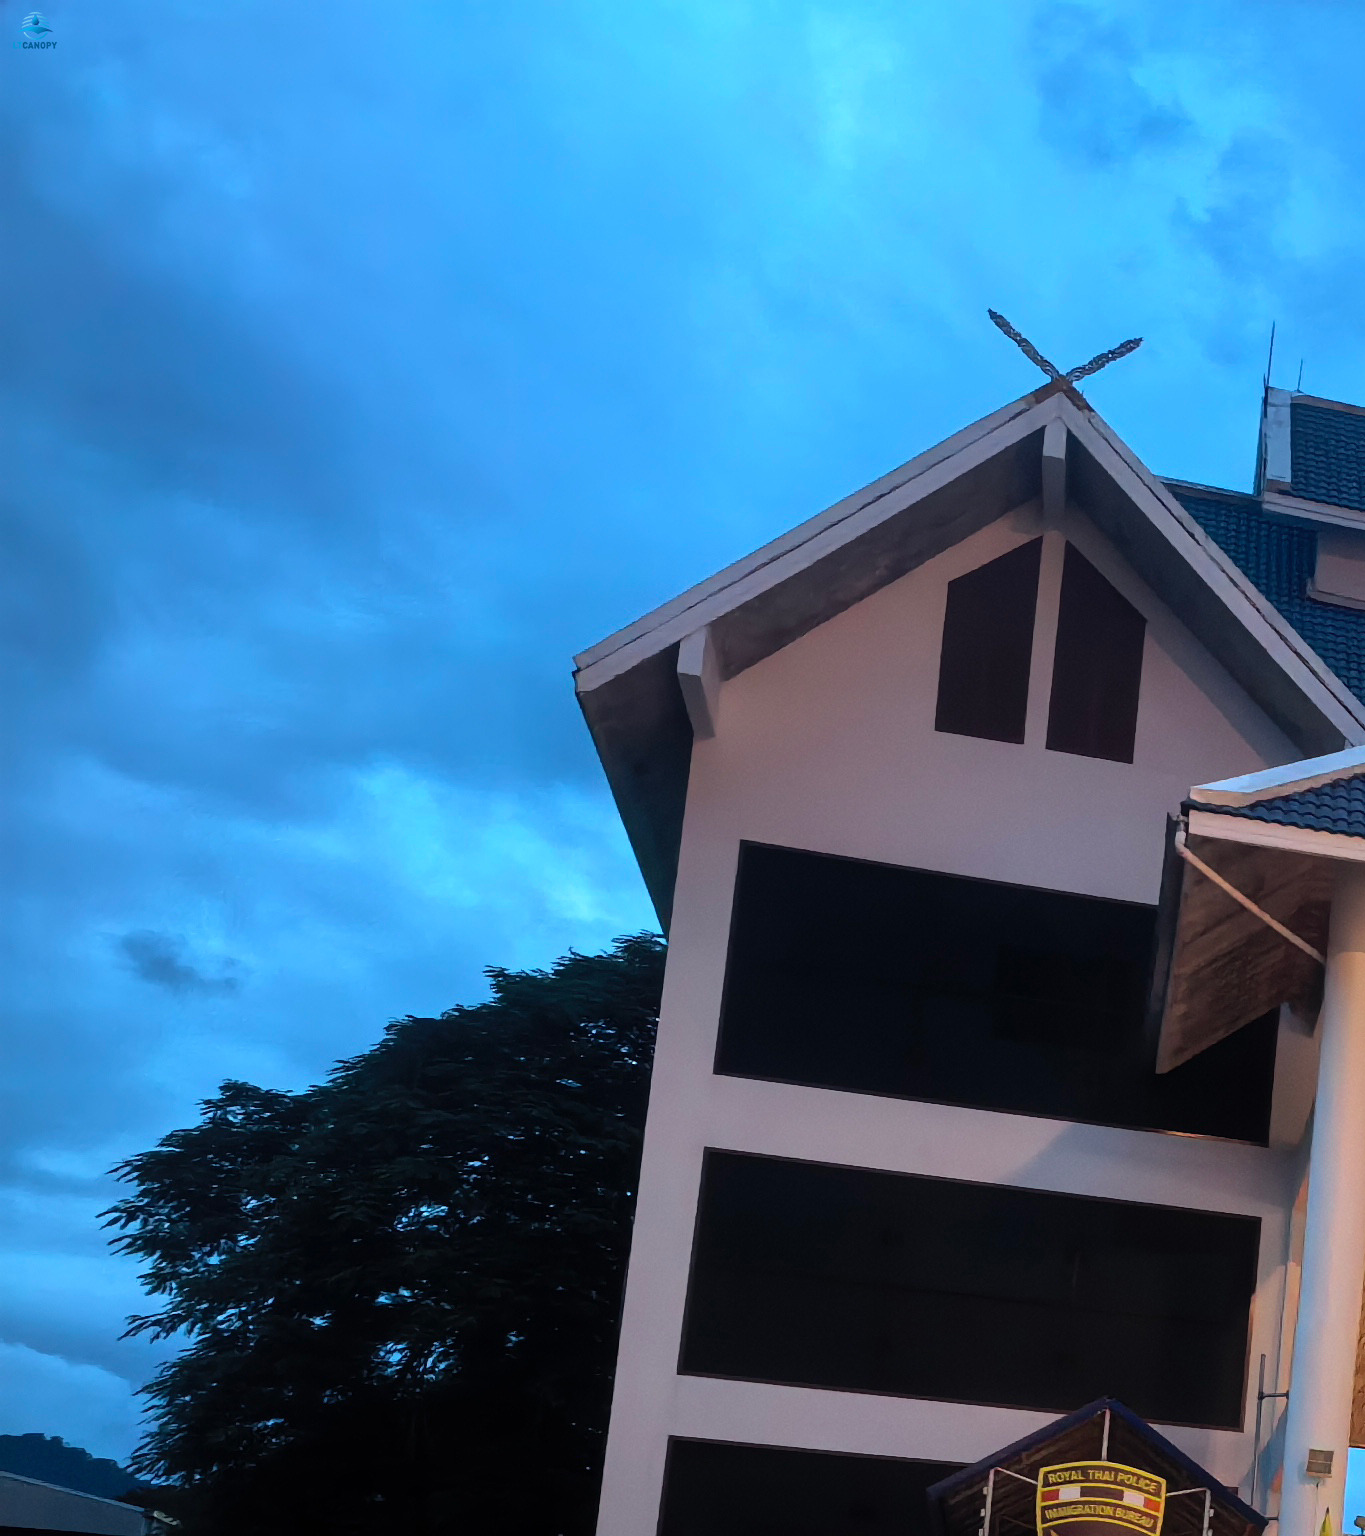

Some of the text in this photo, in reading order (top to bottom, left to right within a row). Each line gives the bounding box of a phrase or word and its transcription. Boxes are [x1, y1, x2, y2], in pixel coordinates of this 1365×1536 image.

[1047, 1469, 1160, 1493] ROYAL THAI POLICE
[1044, 1504, 1154, 1528] IMMIGRATION BUREAU
